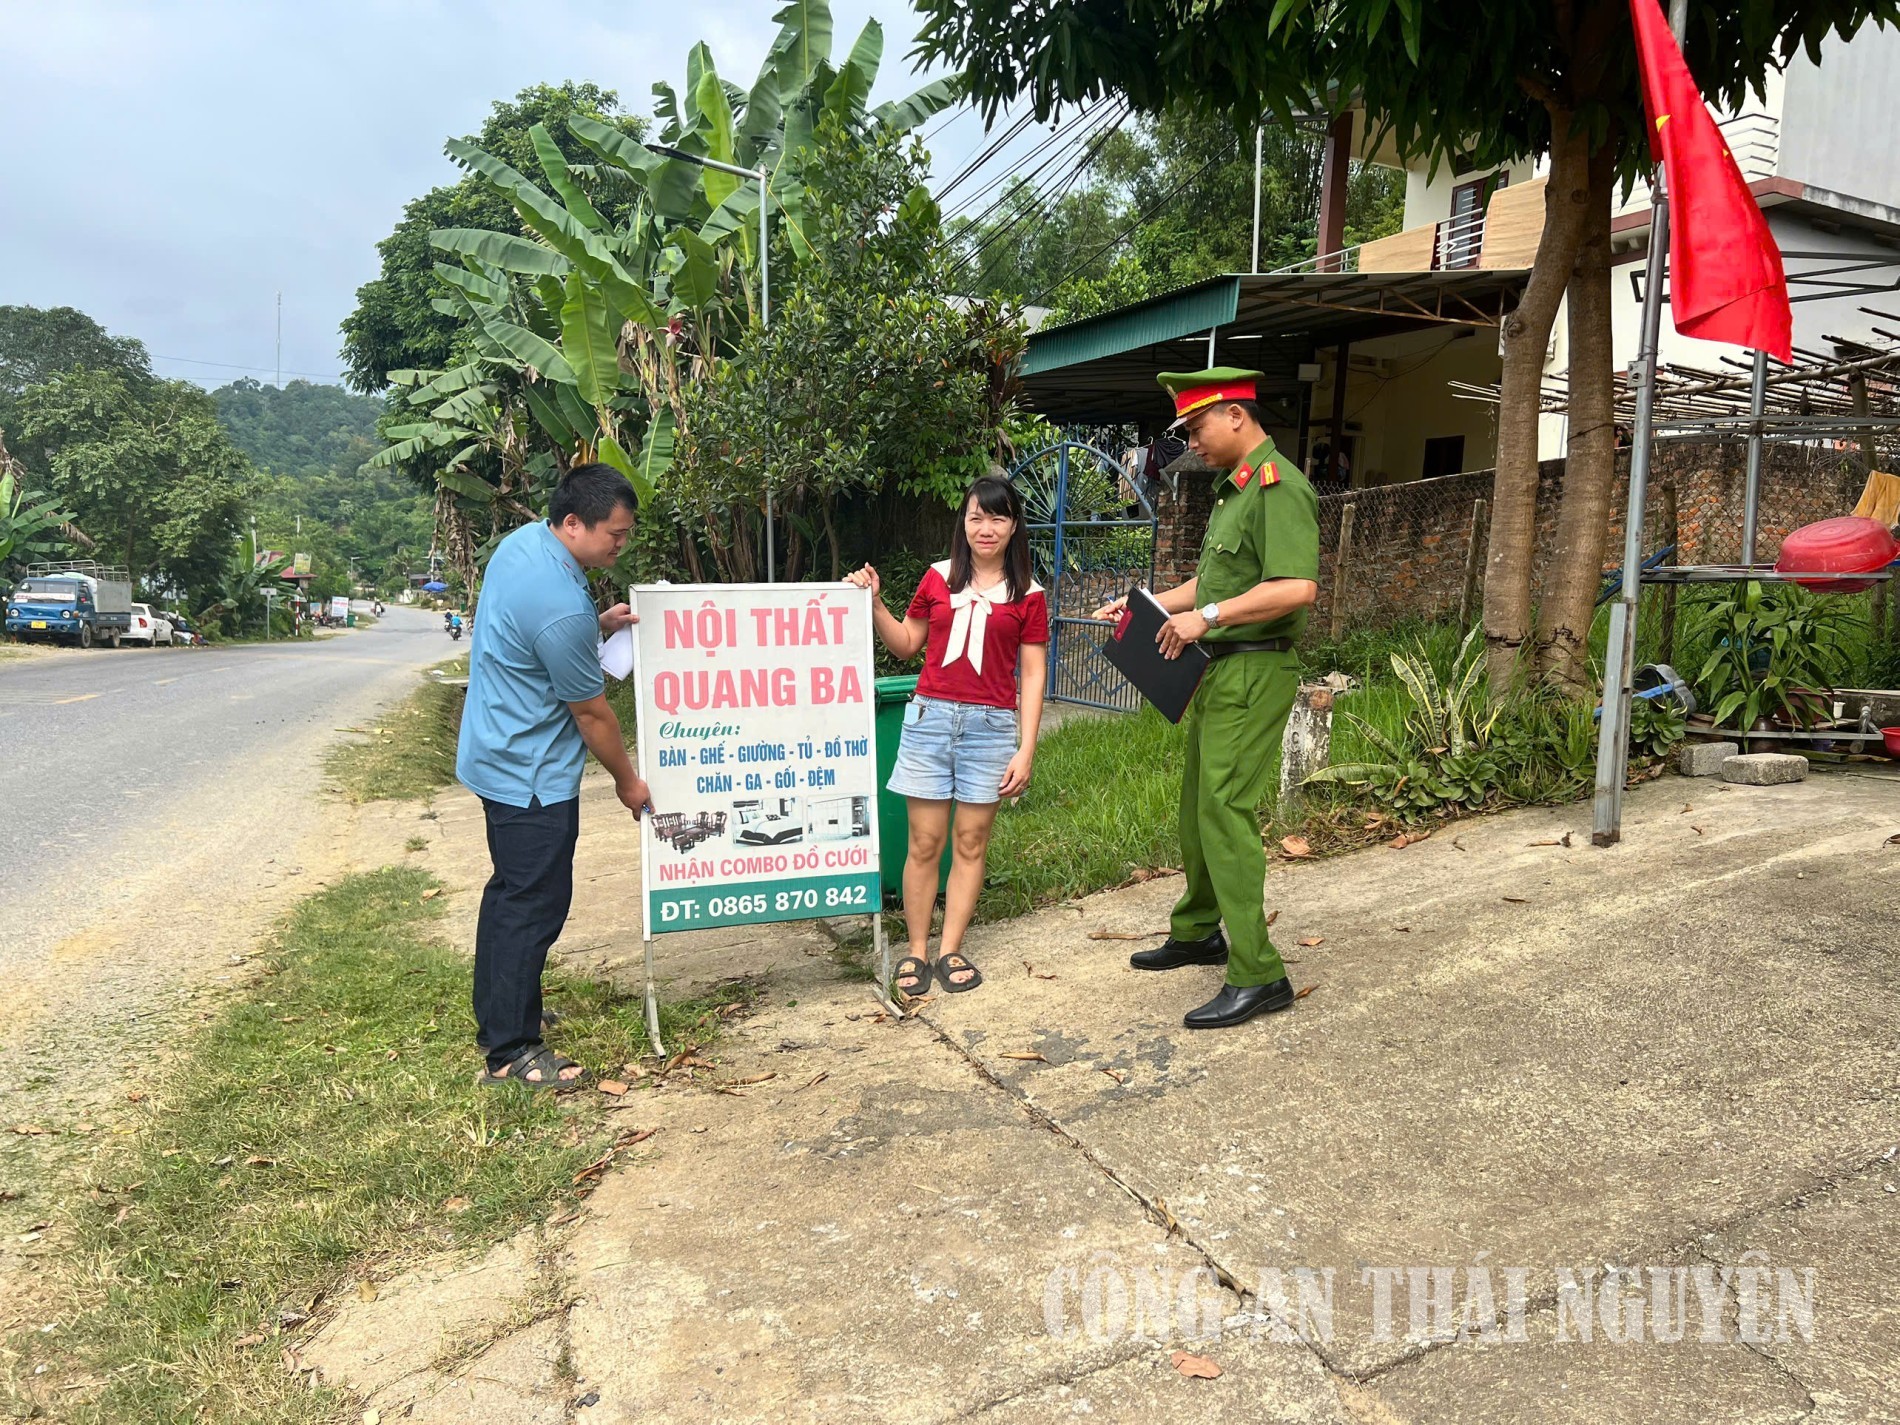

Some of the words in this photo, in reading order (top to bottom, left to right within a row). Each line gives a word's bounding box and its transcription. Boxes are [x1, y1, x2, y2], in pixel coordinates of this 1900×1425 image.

[664, 600, 737, 657] NỘI
[750, 593, 849, 647] THẤT
[653, 667, 796, 715] QUANG
[810, 665, 864, 705] BA
[659, 721, 741, 740] Chuyên:
[659, 745, 687, 767] BÀN
[700, 740, 725, 765] GHẾ
[738, 740, 785, 763] GIƯỜNG
[797, 735, 813, 759] TỦ
[824, 735, 841, 758] ĐỒ
[844, 735, 868, 757] THỜ
[696, 772, 732, 793] CHĂN
[745, 773, 762, 790] GA
[775, 765, 796, 789] GỐI
[808, 766, 835, 790] ĐỆM
[659, 857, 714, 885] NHẬN
[720, 855, 788, 877] COMBO
[792, 845, 819, 870] ĐỒ
[824, 844, 868, 868] CƯỚI
[660, 899, 700, 922] ĐT:
[708, 894, 767, 917] 0865
[775, 889, 818, 911] 870
[825, 885, 867, 907] 842
